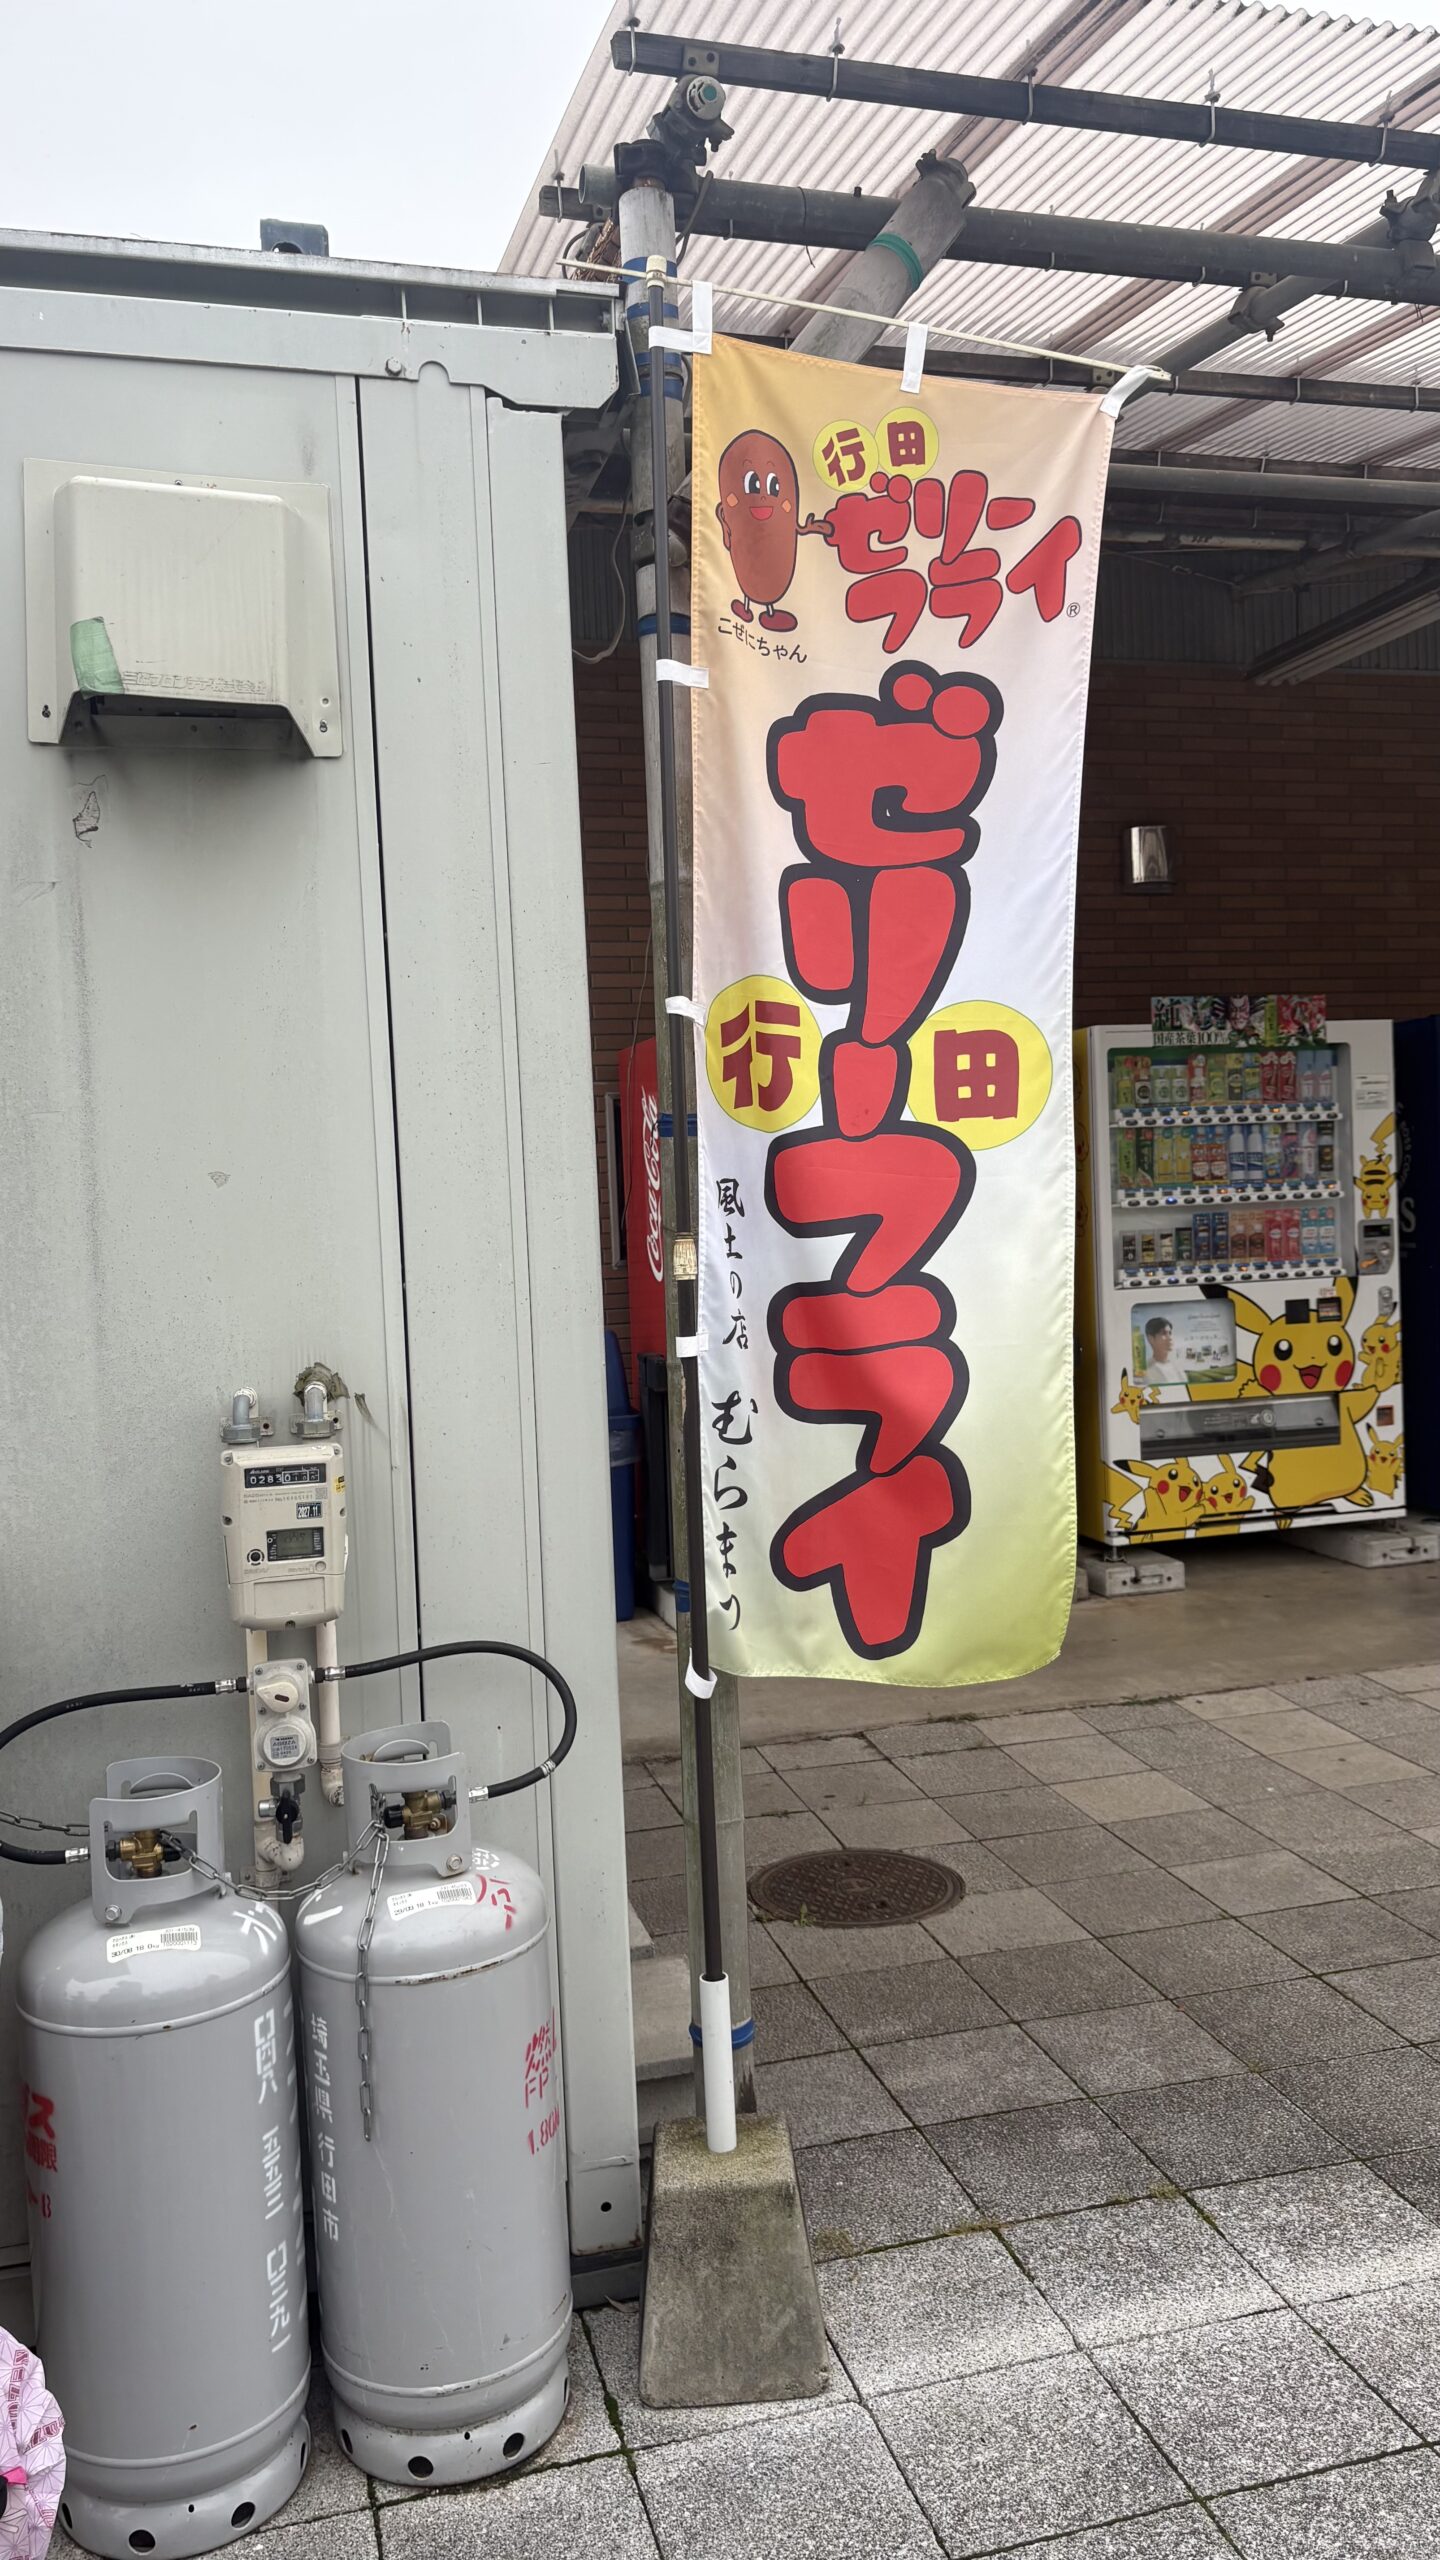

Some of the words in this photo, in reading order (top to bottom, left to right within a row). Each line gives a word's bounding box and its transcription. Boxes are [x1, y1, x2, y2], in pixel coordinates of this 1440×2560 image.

[821, 420, 927, 487] 行田
[717, 617, 808, 664] こぜにちゃん
[641, 1085, 664, 1283] Coca-Cola
[764, 659, 1005, 1661] ゼリーフライ
[716, 1178, 751, 1351] 風土の店
